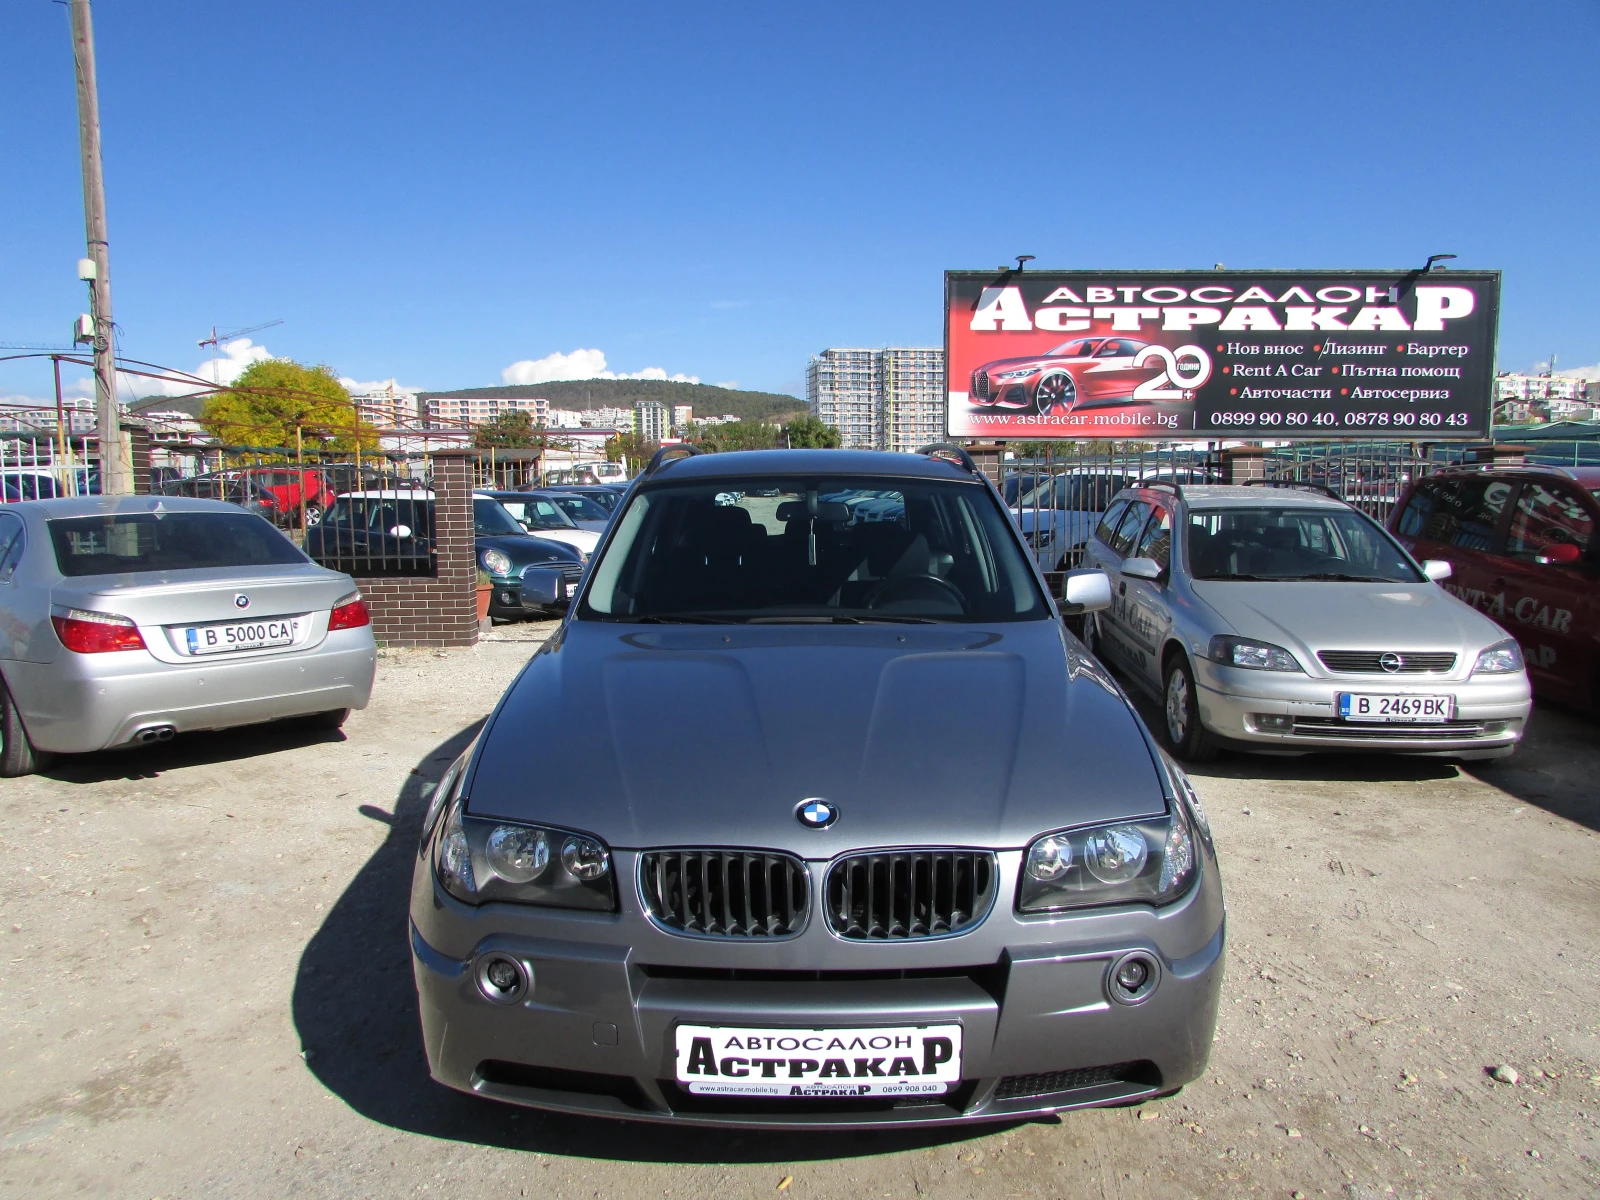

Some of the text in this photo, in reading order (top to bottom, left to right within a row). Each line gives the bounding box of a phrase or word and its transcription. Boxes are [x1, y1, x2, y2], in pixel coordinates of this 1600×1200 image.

[1042, 286, 1399, 303] АВТОСАЛОН
[1226, 343, 1304, 355] Нов внос
[1322, 342, 1387, 355] Лизинг
[1406, 343, 1469, 357] Бартер
[1232, 364, 1323, 377] Rent A Car
[1342, 364, 1460, 379] Пътна помощ
[1239, 386, 1332, 399] Авточасти
[1350, 386, 1450, 402] Автосервиз
[968, 412, 1178, 428] www.astracar.mobile.bg
[1211, 412, 1256, 425] 0899
[1259, 412, 1282, 425] 90
[1285, 412, 1308, 425] 80
[1344, 412, 1389, 425] 0878
[1393, 412, 1415, 425] 90
[1419, 412, 1441, 425] 80
[1444, 412, 1468, 425] 43
[206, 623, 289, 645] B 5000 CA
[1358, 698, 1445, 715] B 2469 BK
[724, 1036, 912, 1051] АВТОСАЛОН
[699, 1085, 779, 1095] www.astracar.mobile.bg
[882, 1086, 938, 1094] 0899 908 040
